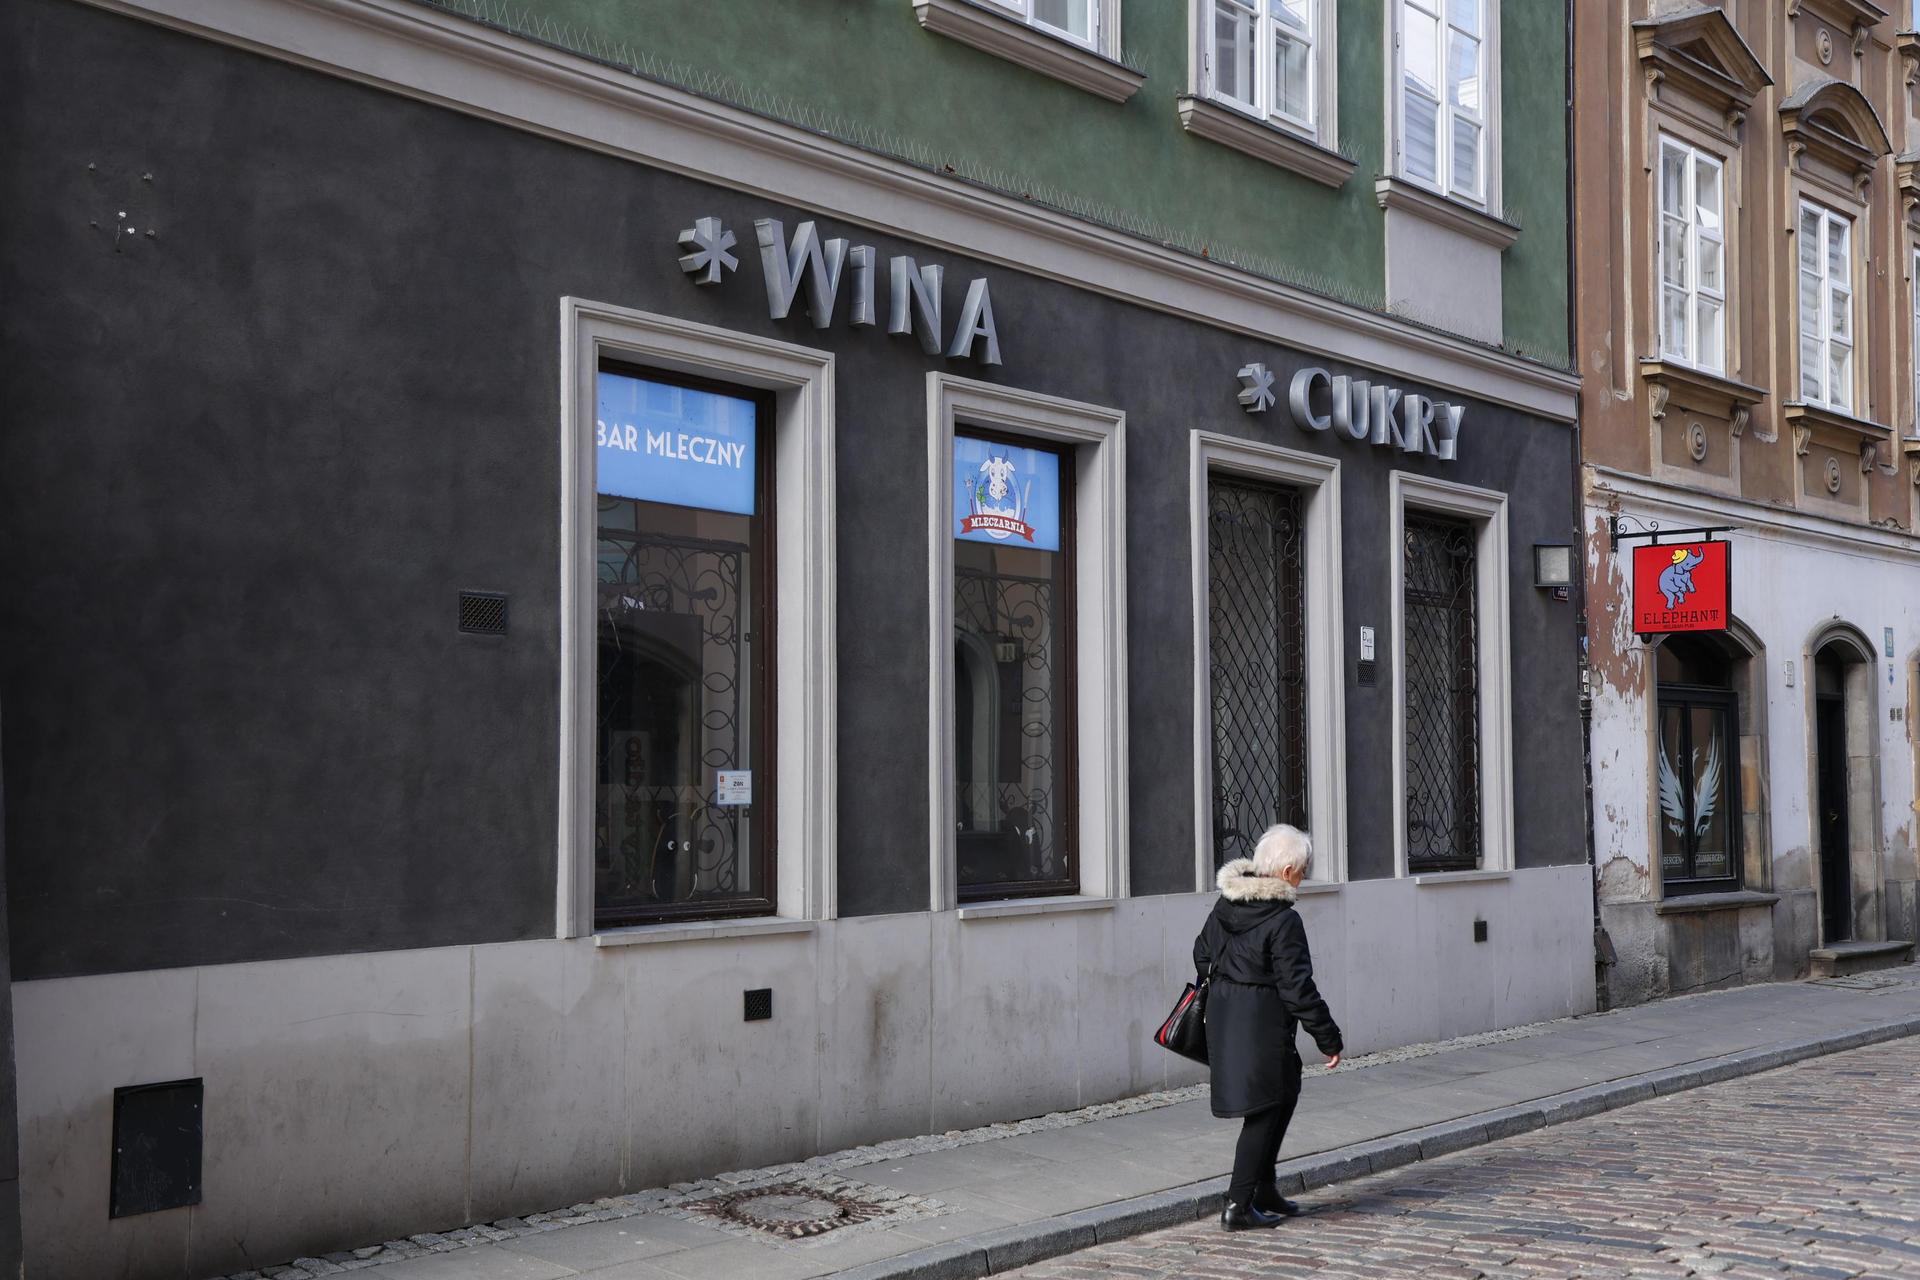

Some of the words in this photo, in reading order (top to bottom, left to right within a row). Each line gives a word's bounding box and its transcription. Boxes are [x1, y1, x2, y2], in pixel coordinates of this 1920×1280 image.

[753, 217, 1002, 366] WINA
[1289, 367, 1466, 461] CUKRY
[597, 420, 638, 452] BAR
[646, 428, 746, 469] MLECZNY
[970, 516, 1026, 534] MLECZARNIA
[1643, 609, 1719, 625] ELEPHANT
